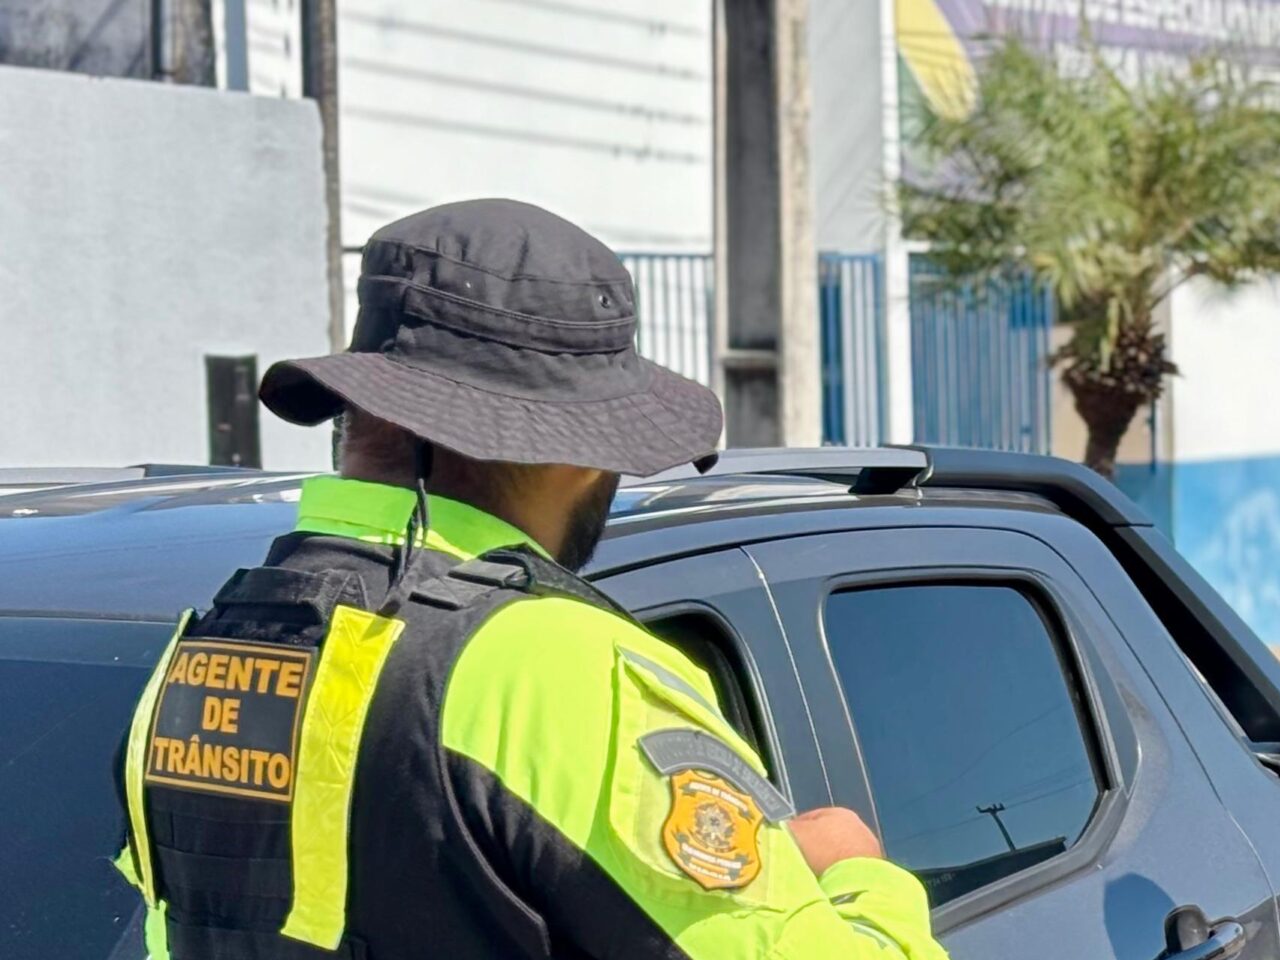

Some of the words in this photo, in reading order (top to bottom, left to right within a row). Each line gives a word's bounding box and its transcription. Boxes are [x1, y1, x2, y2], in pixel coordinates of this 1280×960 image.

[168, 652, 304, 698] AGENTE
[202, 696, 240, 734] DE
[154, 735, 291, 789] TRÂNSITO
